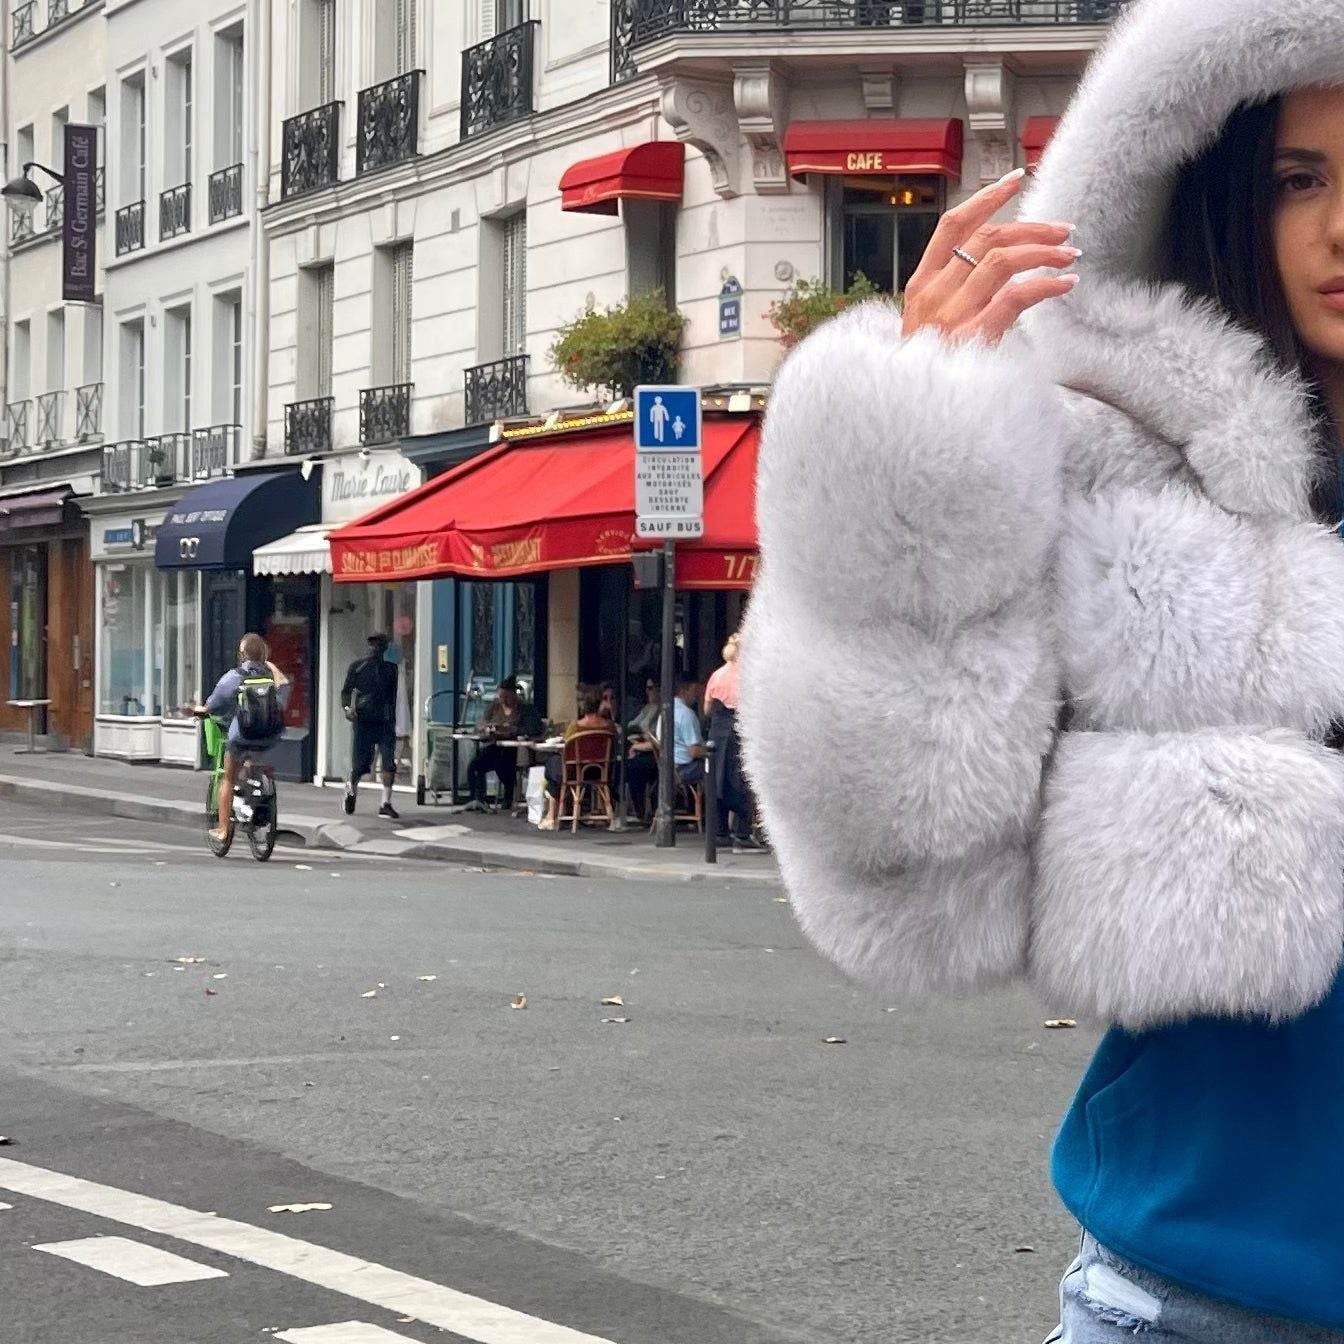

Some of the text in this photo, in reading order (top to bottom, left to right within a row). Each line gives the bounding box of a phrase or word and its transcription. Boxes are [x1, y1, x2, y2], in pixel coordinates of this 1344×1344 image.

[71, 136, 88, 169] Café
[847, 152, 883, 170] CAFE
[72, 172, 88, 233] Germain
[71, 253, 87, 277] Bac
[331, 470, 368, 502] Marie
[640, 522, 701, 532] SAUF BUS
